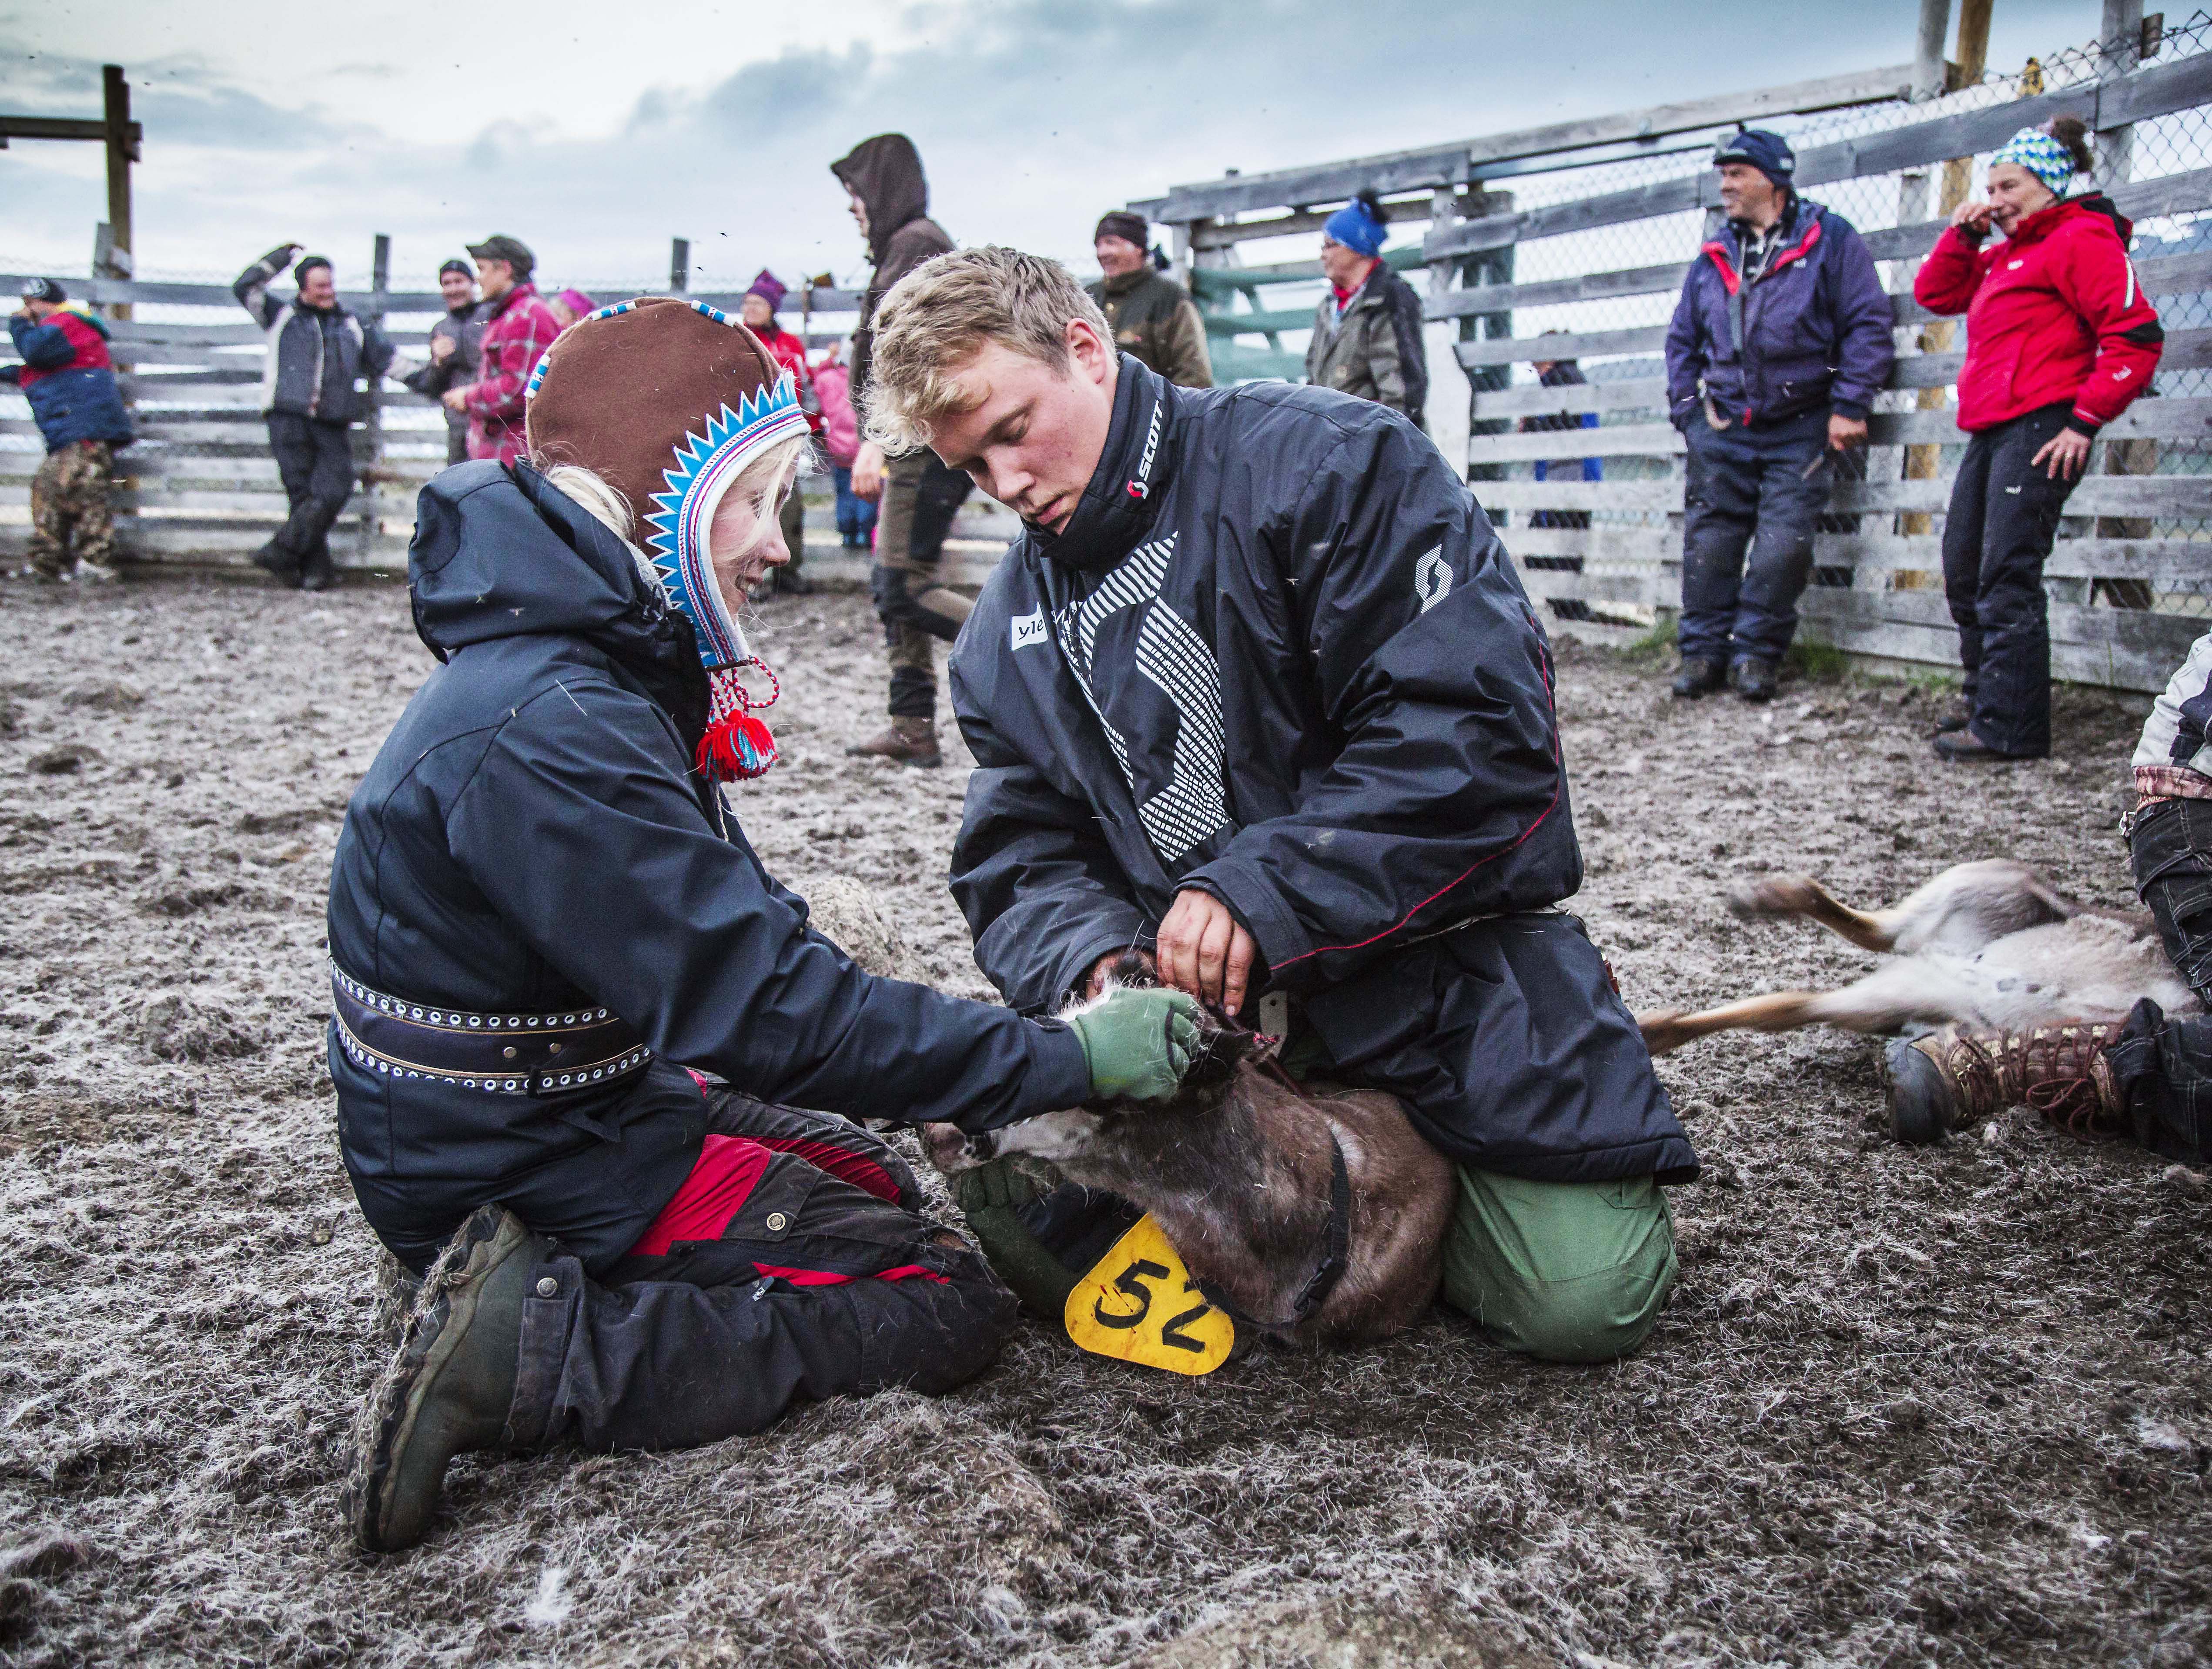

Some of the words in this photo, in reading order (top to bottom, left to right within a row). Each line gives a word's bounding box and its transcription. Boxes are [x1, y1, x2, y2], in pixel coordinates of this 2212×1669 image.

[1138, 400, 1162, 482] SCOTT
[1018, 619, 1044, 640] yle
[1094, 1259, 1211, 1354] 52
